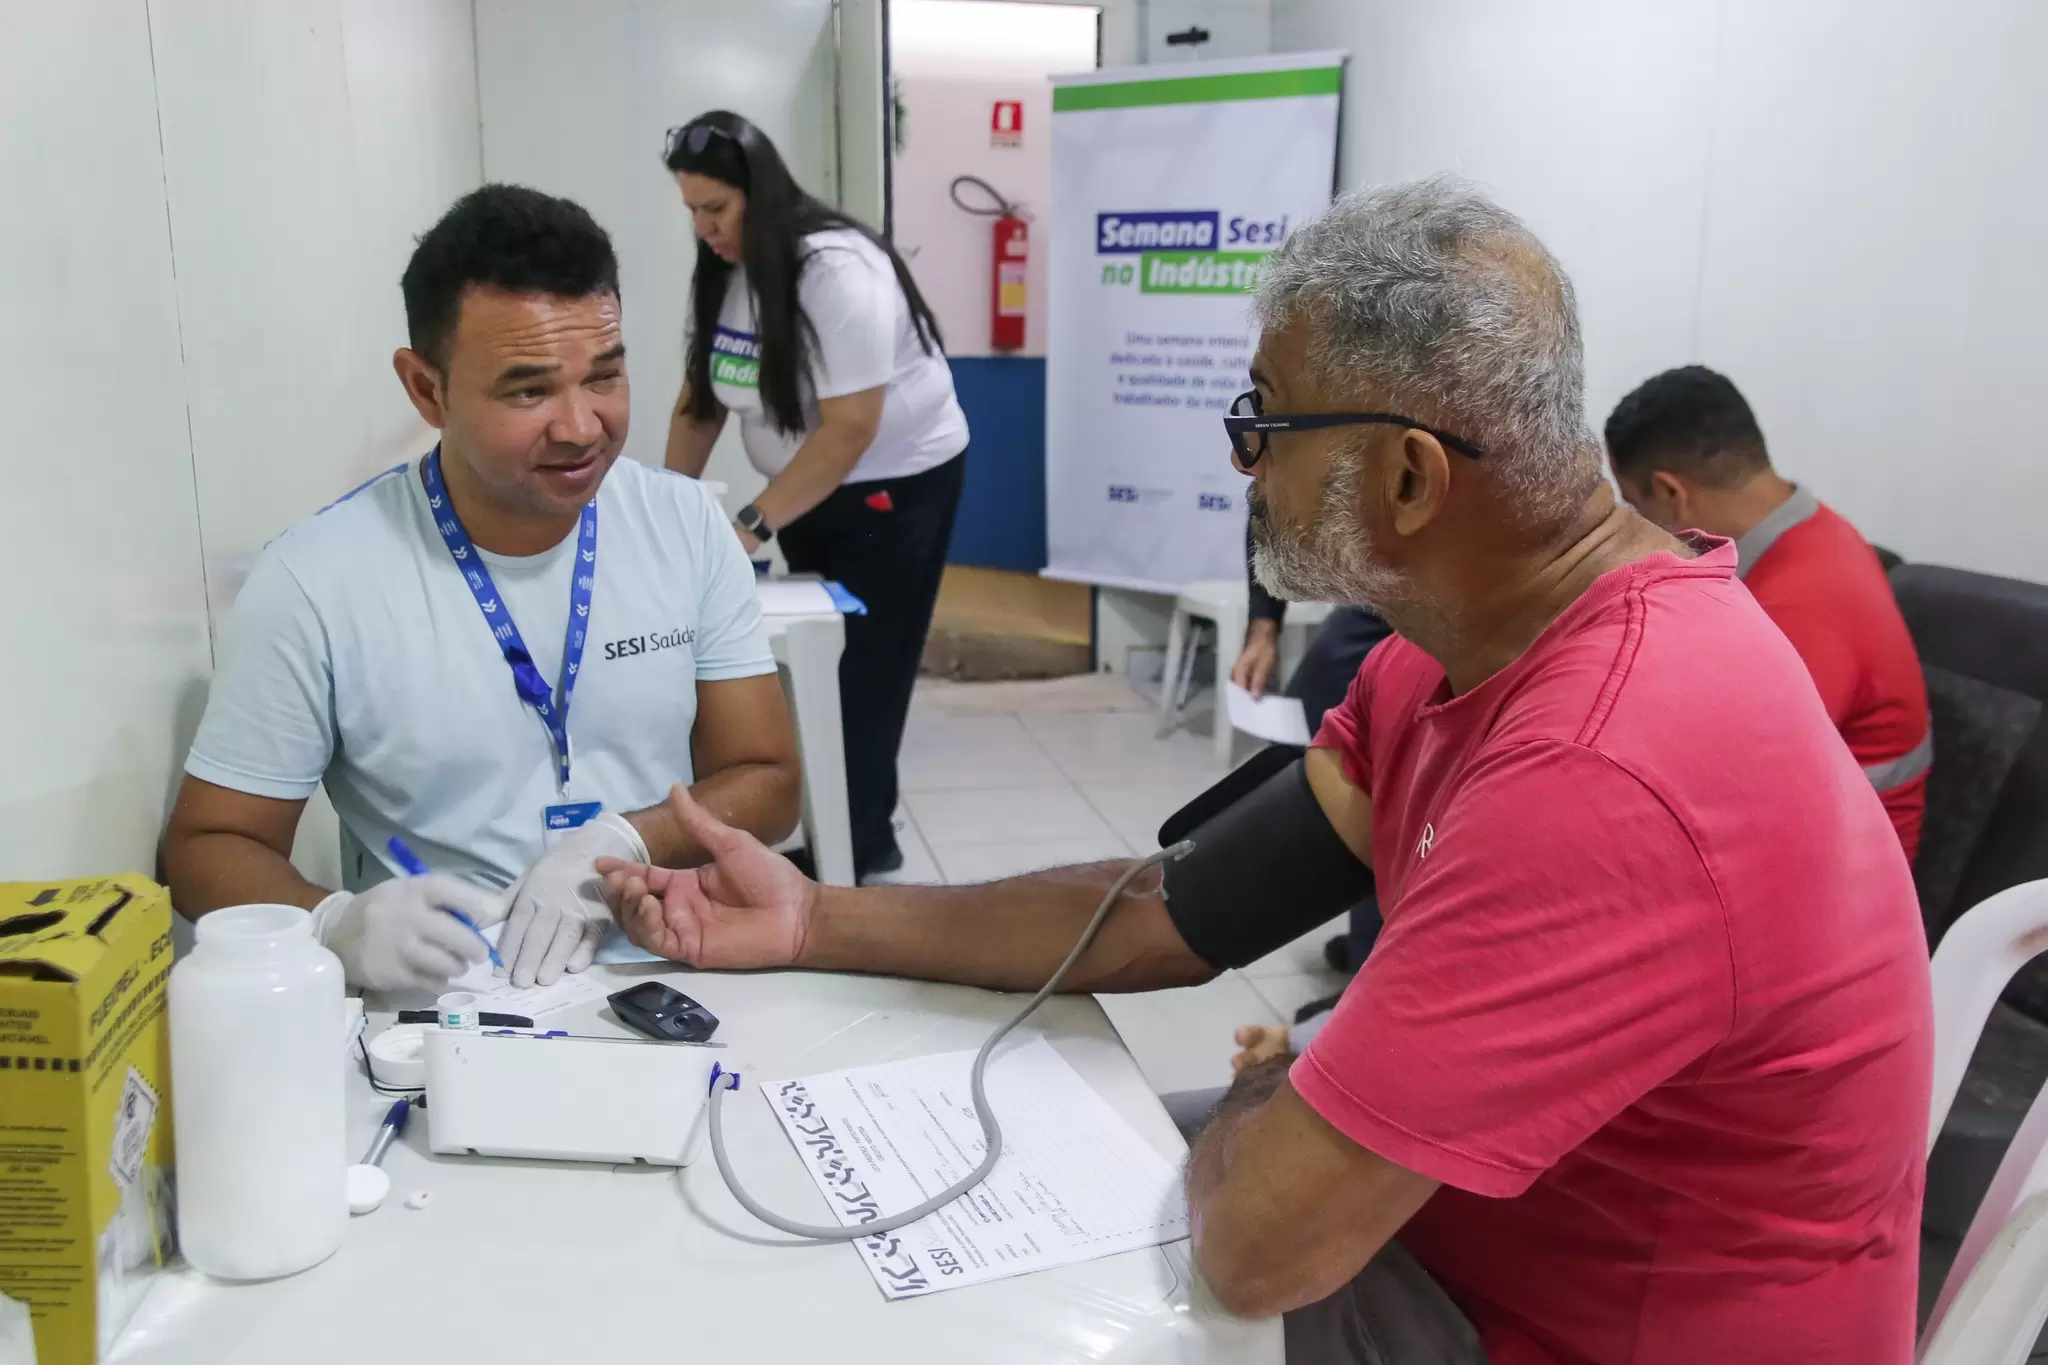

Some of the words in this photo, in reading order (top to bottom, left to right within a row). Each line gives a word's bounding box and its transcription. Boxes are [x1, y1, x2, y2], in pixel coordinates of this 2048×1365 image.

[1101, 217, 1214, 247] Semana
[1226, 214, 1289, 246] Sesi
[1102, 264, 1134, 286] na
[1148, 254, 1262, 288] Indústr
[714, 333, 762, 358] mana
[604, 636, 646, 660] SESI
[650, 624, 695, 651] Saúde
[928, 1247, 964, 1275] SESI
